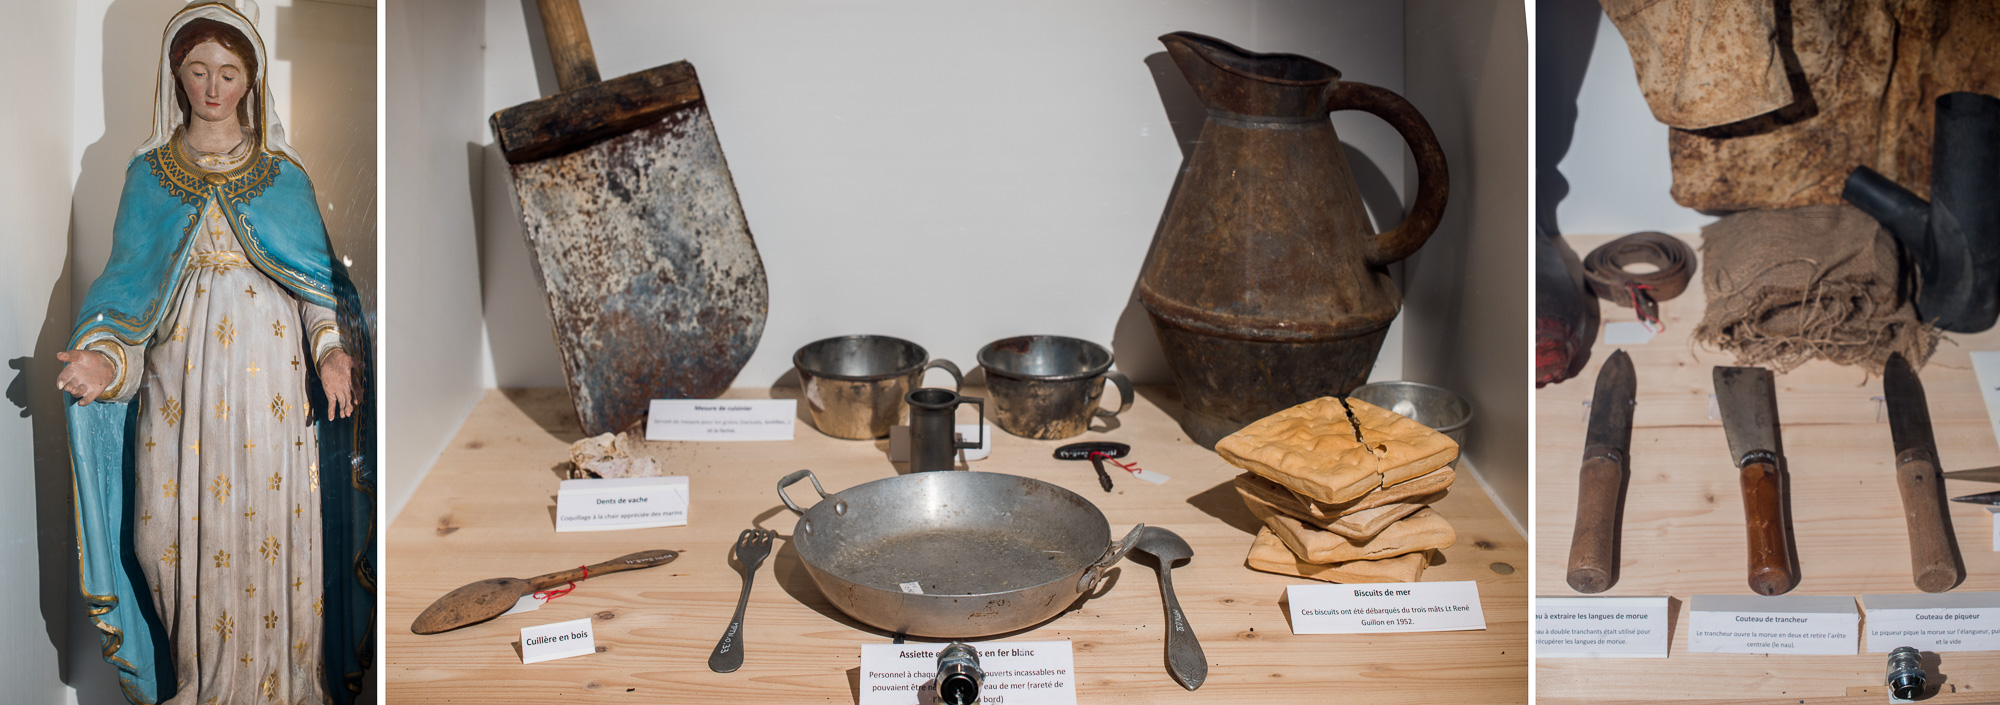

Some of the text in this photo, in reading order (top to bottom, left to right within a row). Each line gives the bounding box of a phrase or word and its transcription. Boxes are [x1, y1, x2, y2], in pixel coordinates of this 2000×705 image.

[1365, 606, 1400, 616] débarqués
[526, 636, 557, 646] Cuillère
[571, 631, 588, 639] bois
[998, 649, 1010, 657] fer
[1012, 648, 1034, 657] blanc
[914, 671, 935, 680] chaqu
[872, 684, 909, 692] pouvaient
[1028, 681, 1052, 690] (rareté
